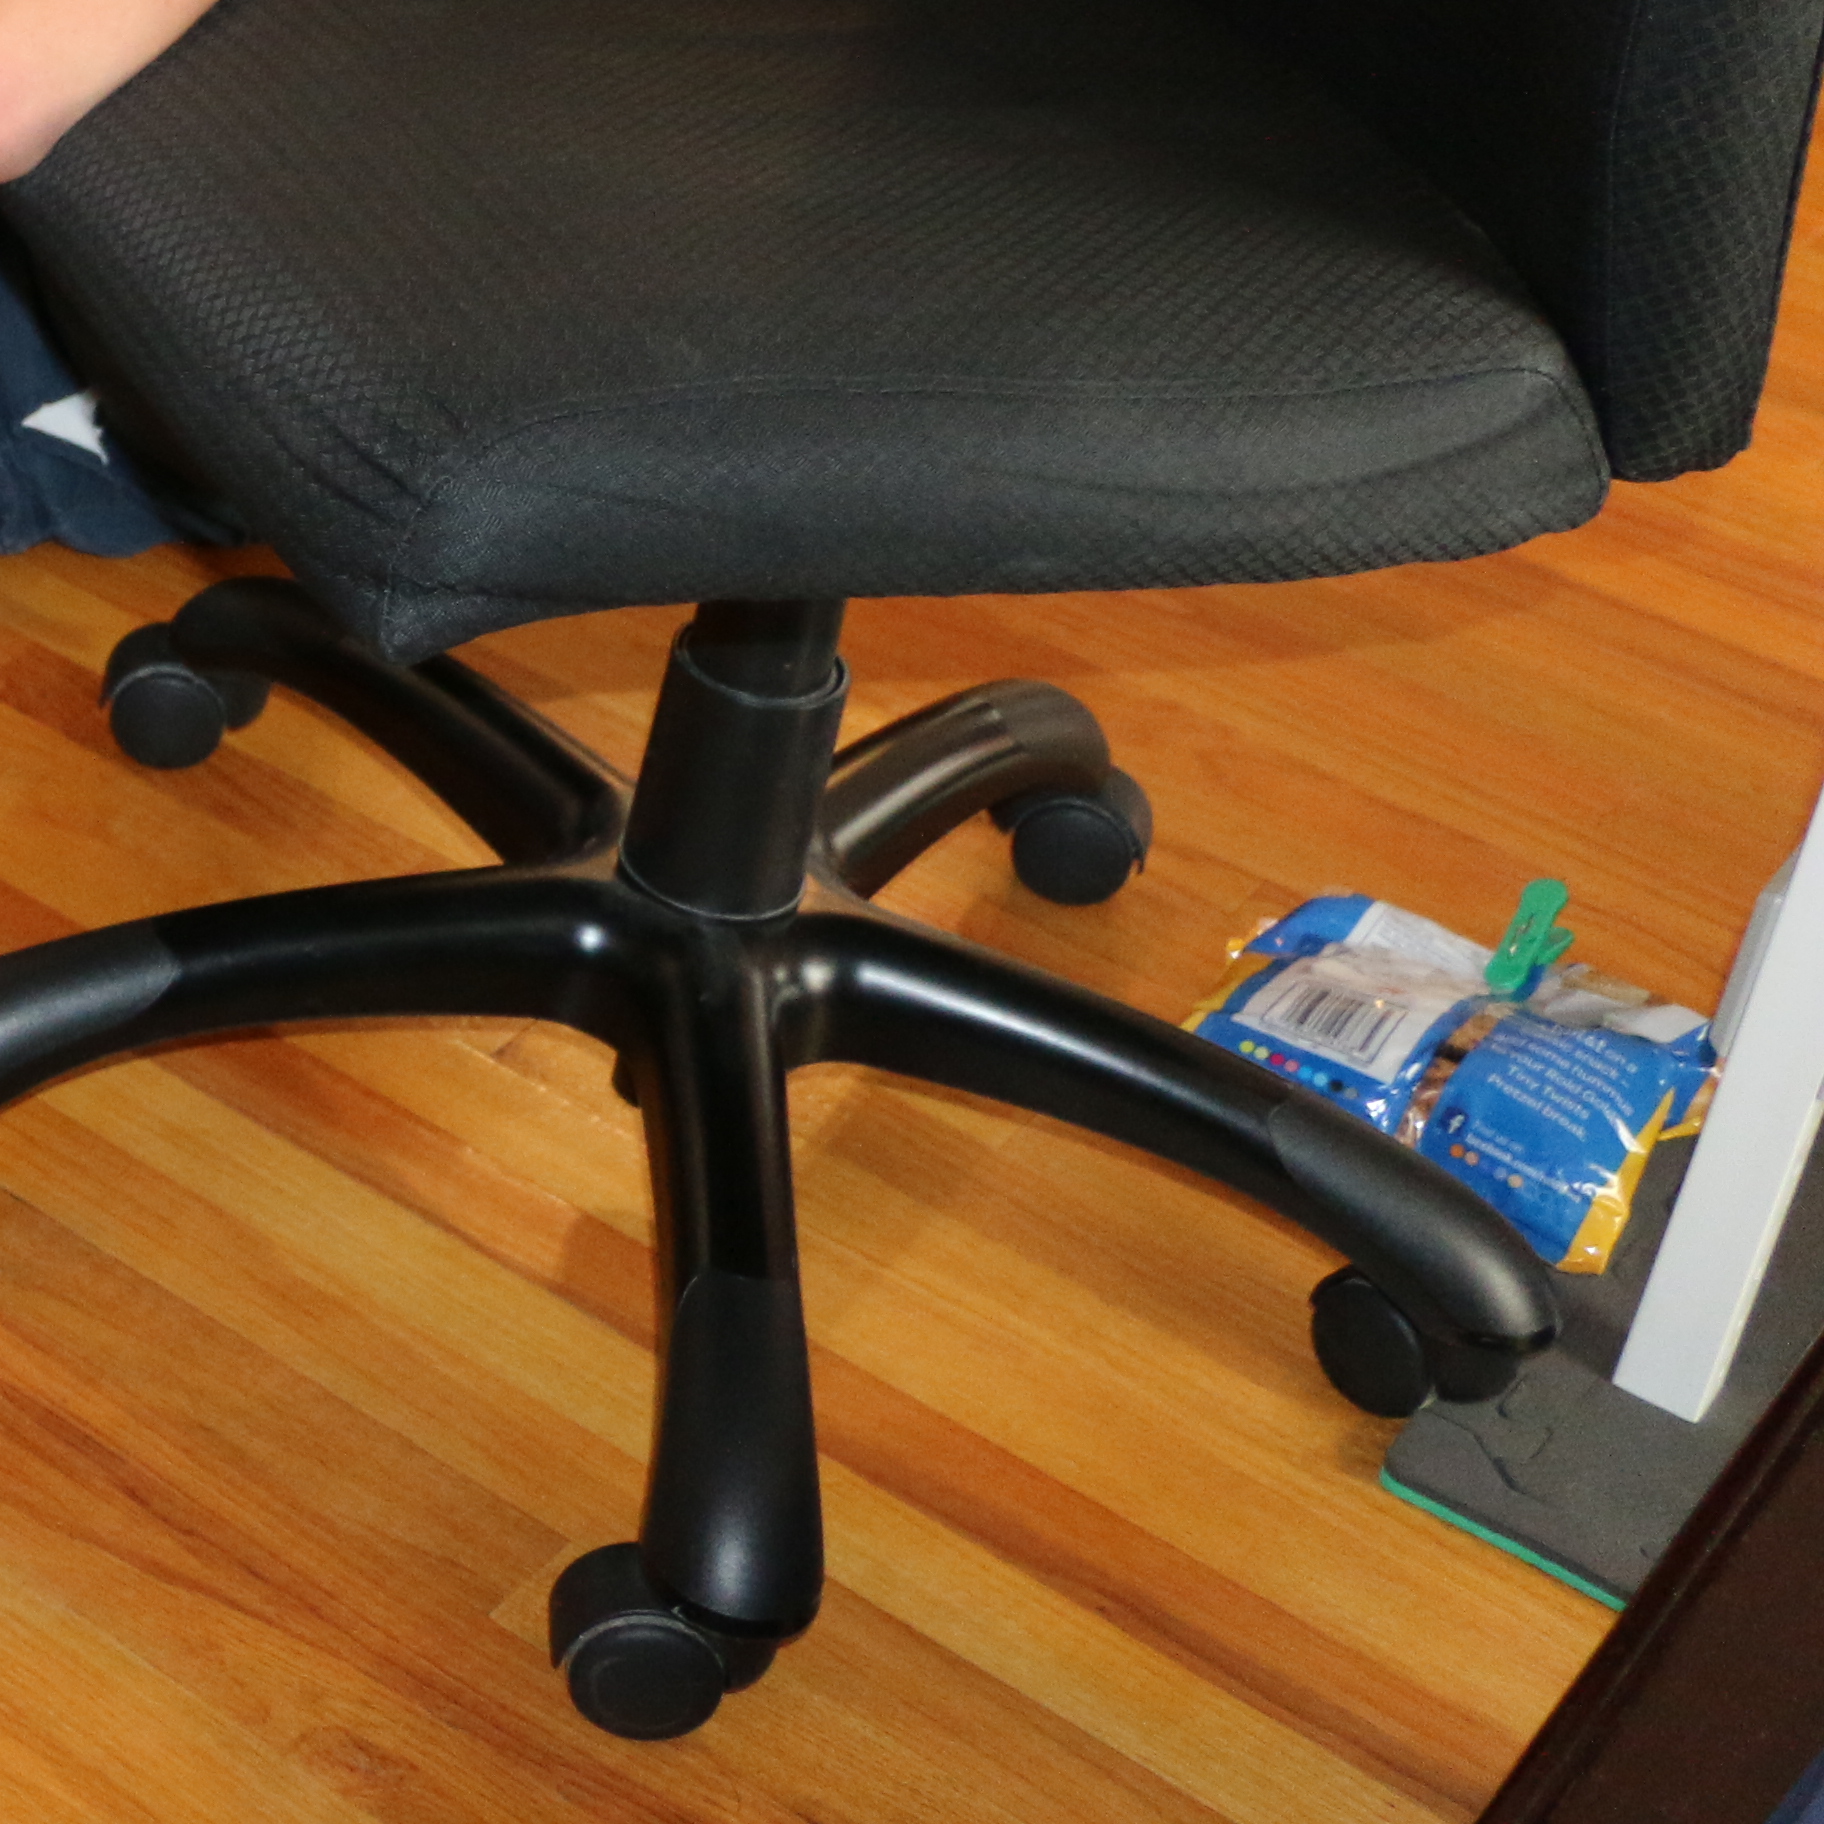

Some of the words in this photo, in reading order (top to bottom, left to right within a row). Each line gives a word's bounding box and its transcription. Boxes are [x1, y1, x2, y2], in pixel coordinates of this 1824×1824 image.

[1487, 1073, 1543, 1110] Pretzel
[1508, 1063, 1542, 1091] Tiny
[1542, 1084, 1592, 1120] Twists
